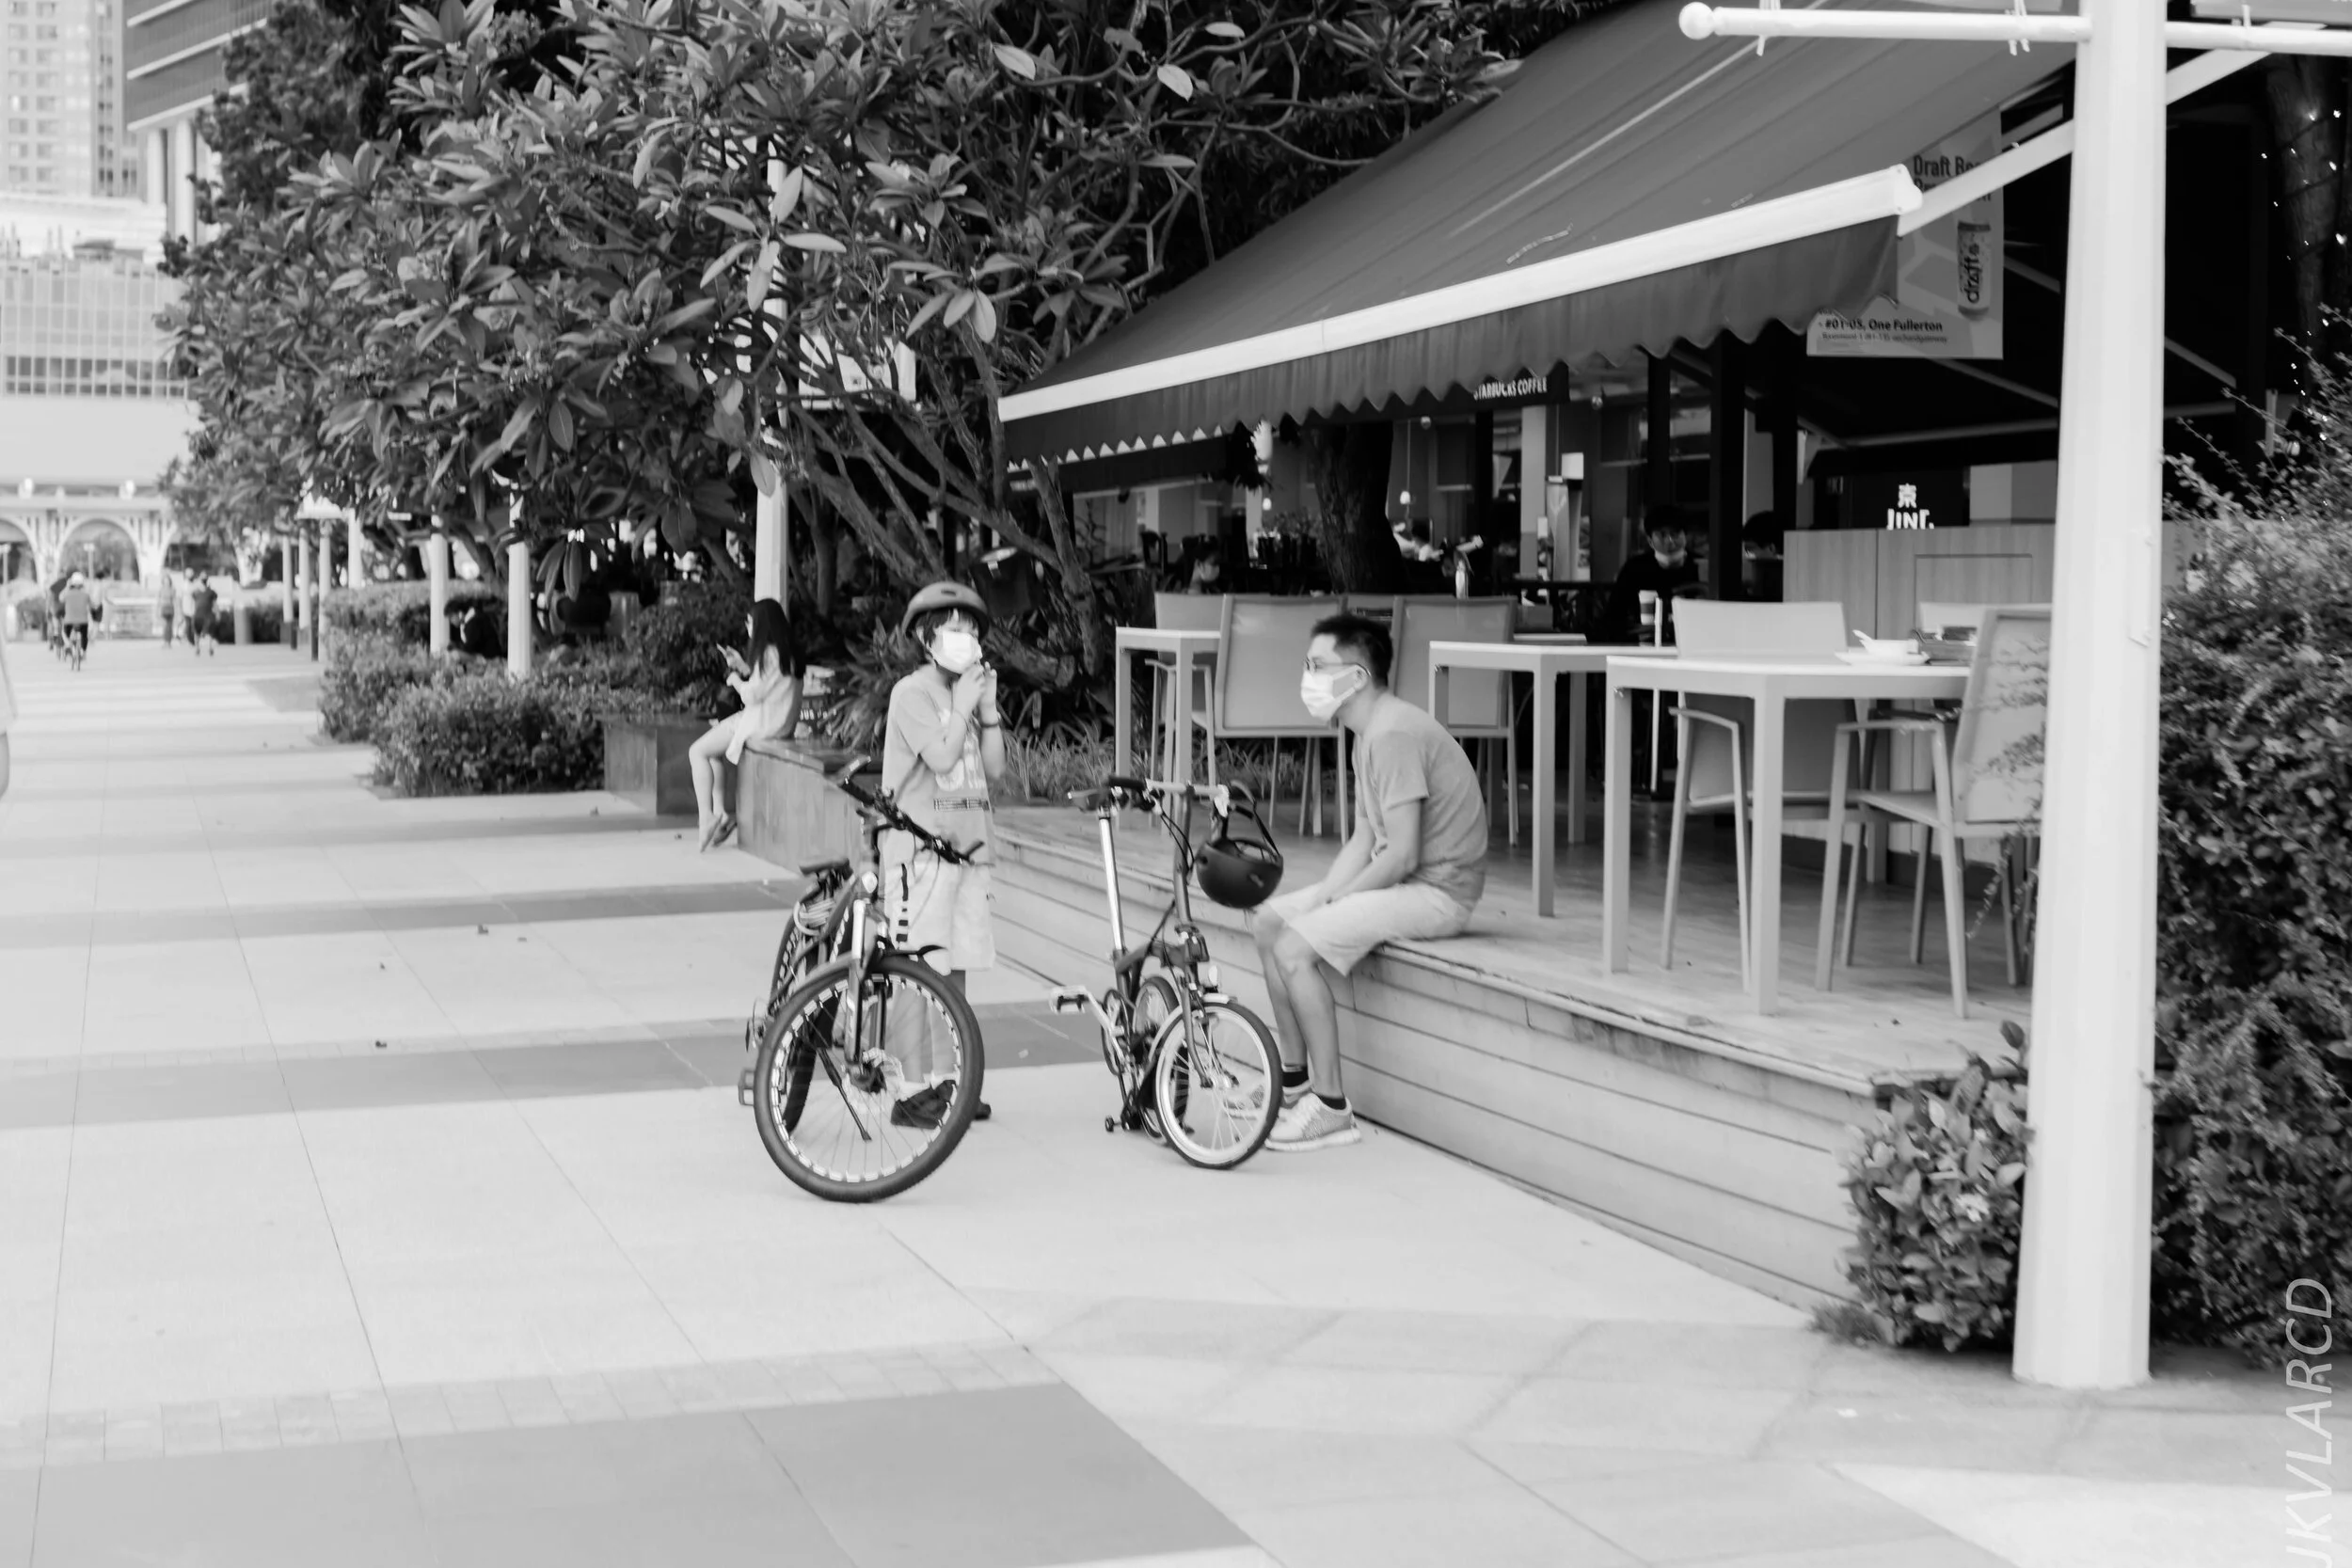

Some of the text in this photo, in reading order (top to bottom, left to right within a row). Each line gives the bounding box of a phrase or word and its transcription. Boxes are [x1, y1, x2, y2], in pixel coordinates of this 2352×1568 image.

[1914, 154, 1951, 178] Draft
[1868, 318, 1891, 331] One
[1893, 318, 1944, 332] Fullerton
